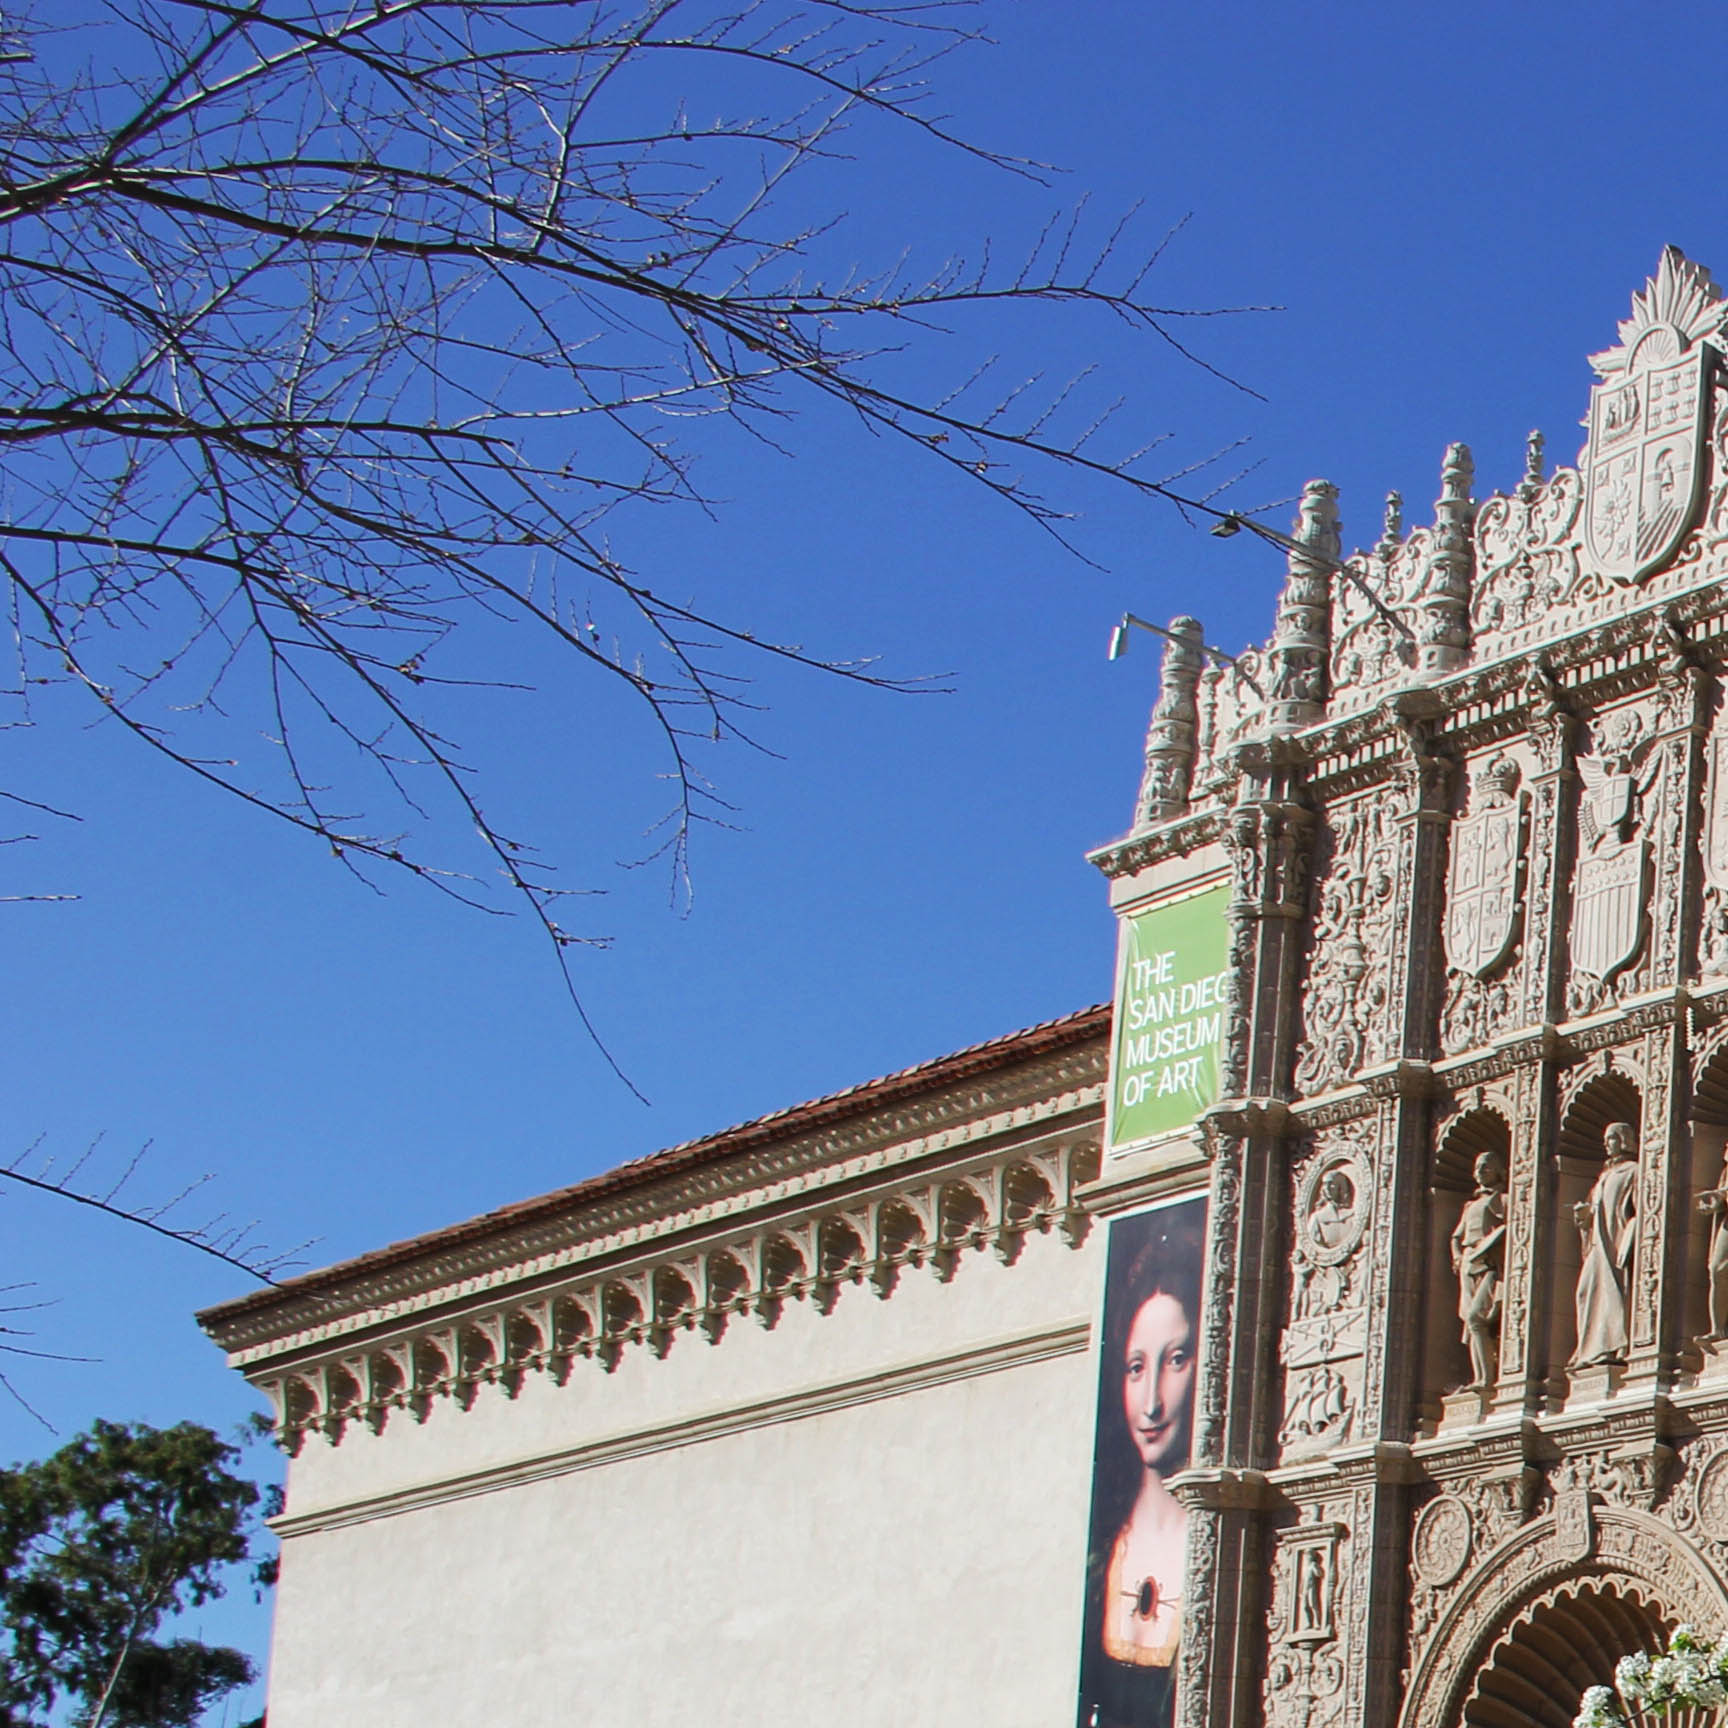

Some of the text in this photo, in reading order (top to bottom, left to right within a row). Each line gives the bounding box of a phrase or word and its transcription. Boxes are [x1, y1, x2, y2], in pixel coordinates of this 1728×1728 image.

[1132, 951, 1176, 991] THE
[1129, 988, 1176, 1030] SAN
[1126, 1012, 1220, 1069] MUSEUM
[1123, 1056, 1203, 1107] OF ART
